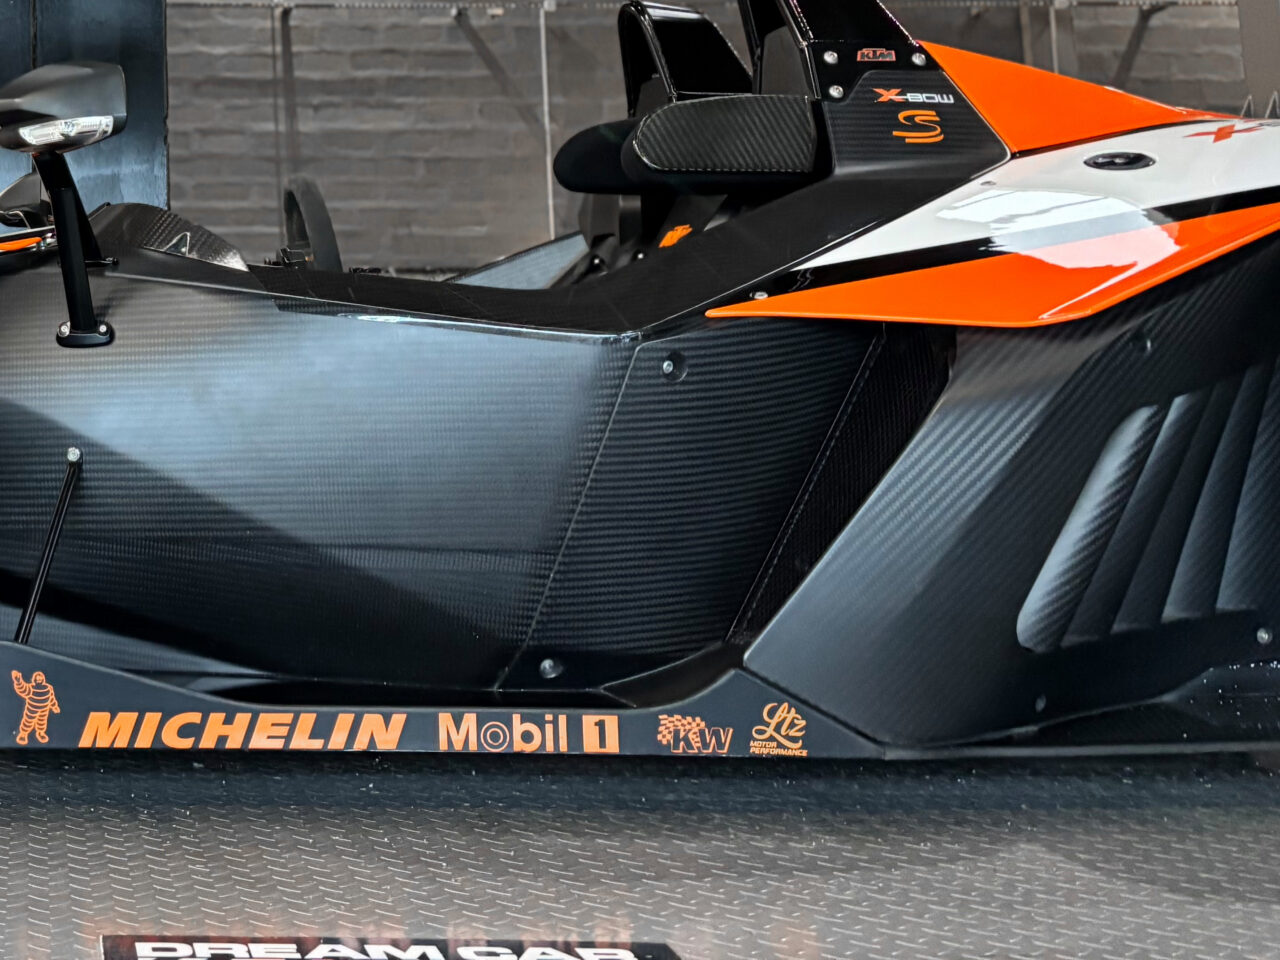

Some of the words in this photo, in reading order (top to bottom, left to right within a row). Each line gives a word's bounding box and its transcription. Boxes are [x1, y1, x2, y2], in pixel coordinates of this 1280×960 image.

[858, 49, 895, 61] KTM
[78, 711, 407, 750] MICHELIN
[438, 712, 568, 753] Mobil
[670, 727, 734, 754] KW
[749, 740, 777, 749] MOTOR
[749, 747, 808, 757] PERFORMANCE
[134, 941, 446, 960] DREAM
[456, 946, 639, 960] CAR
